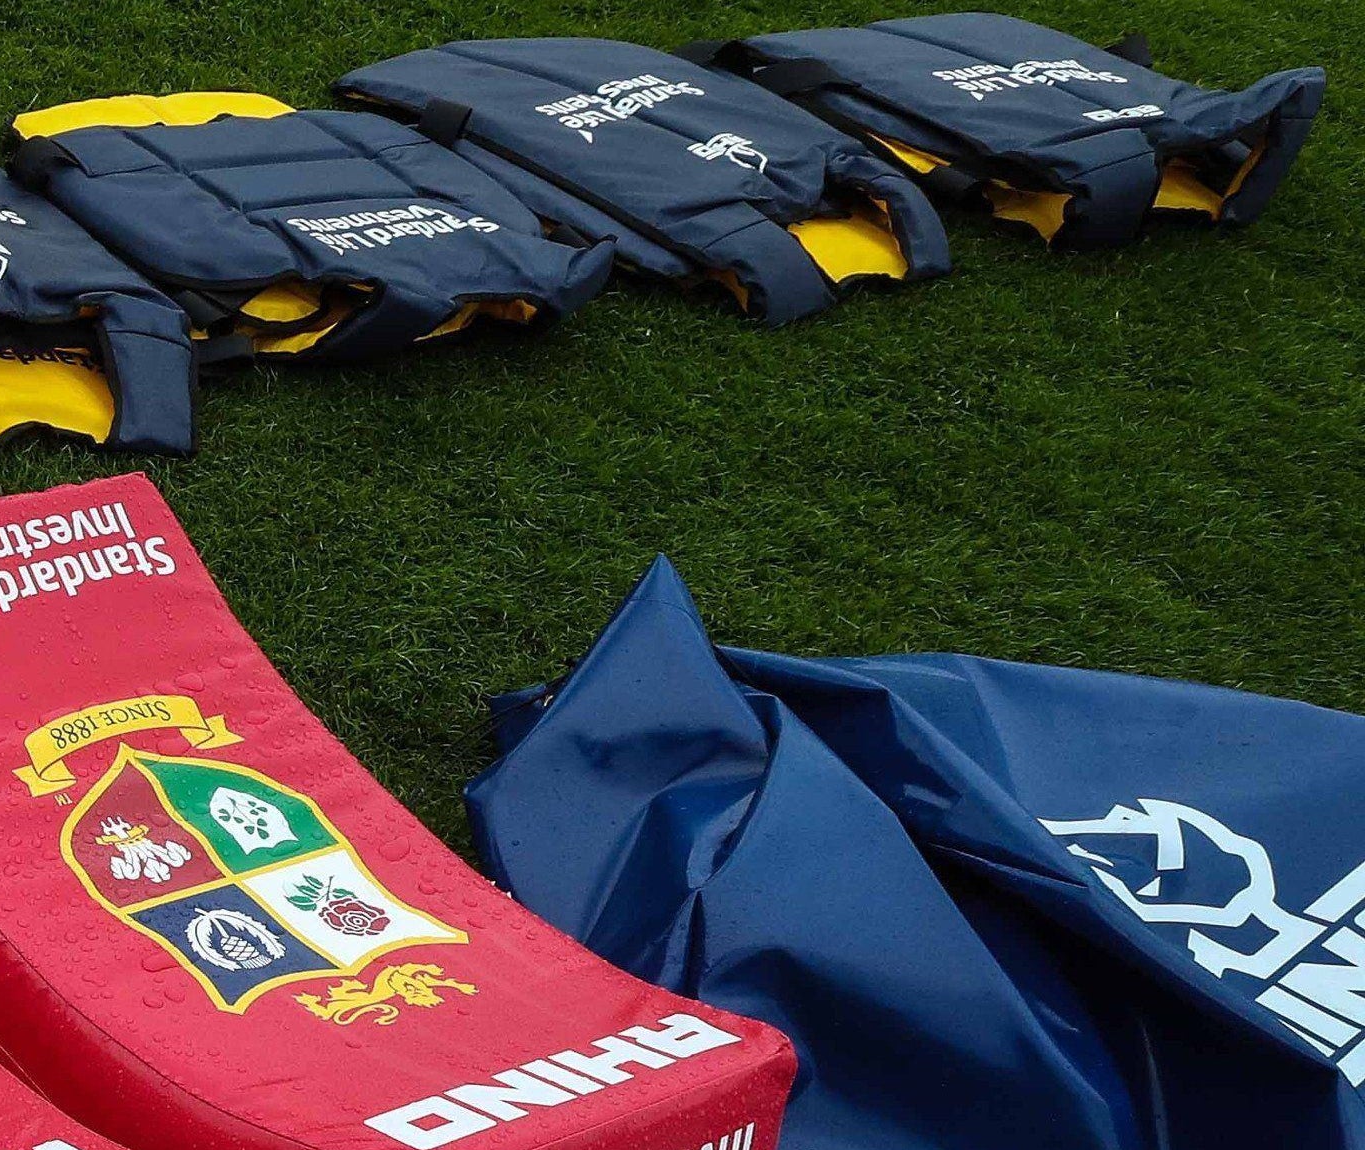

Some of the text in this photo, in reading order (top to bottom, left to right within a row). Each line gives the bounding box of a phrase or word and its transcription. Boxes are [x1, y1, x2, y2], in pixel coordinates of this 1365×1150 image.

[559, 110, 617, 128] Life
[50, 715, 99, 749] 1888
[363, 1013, 742, 1150] RHINO
